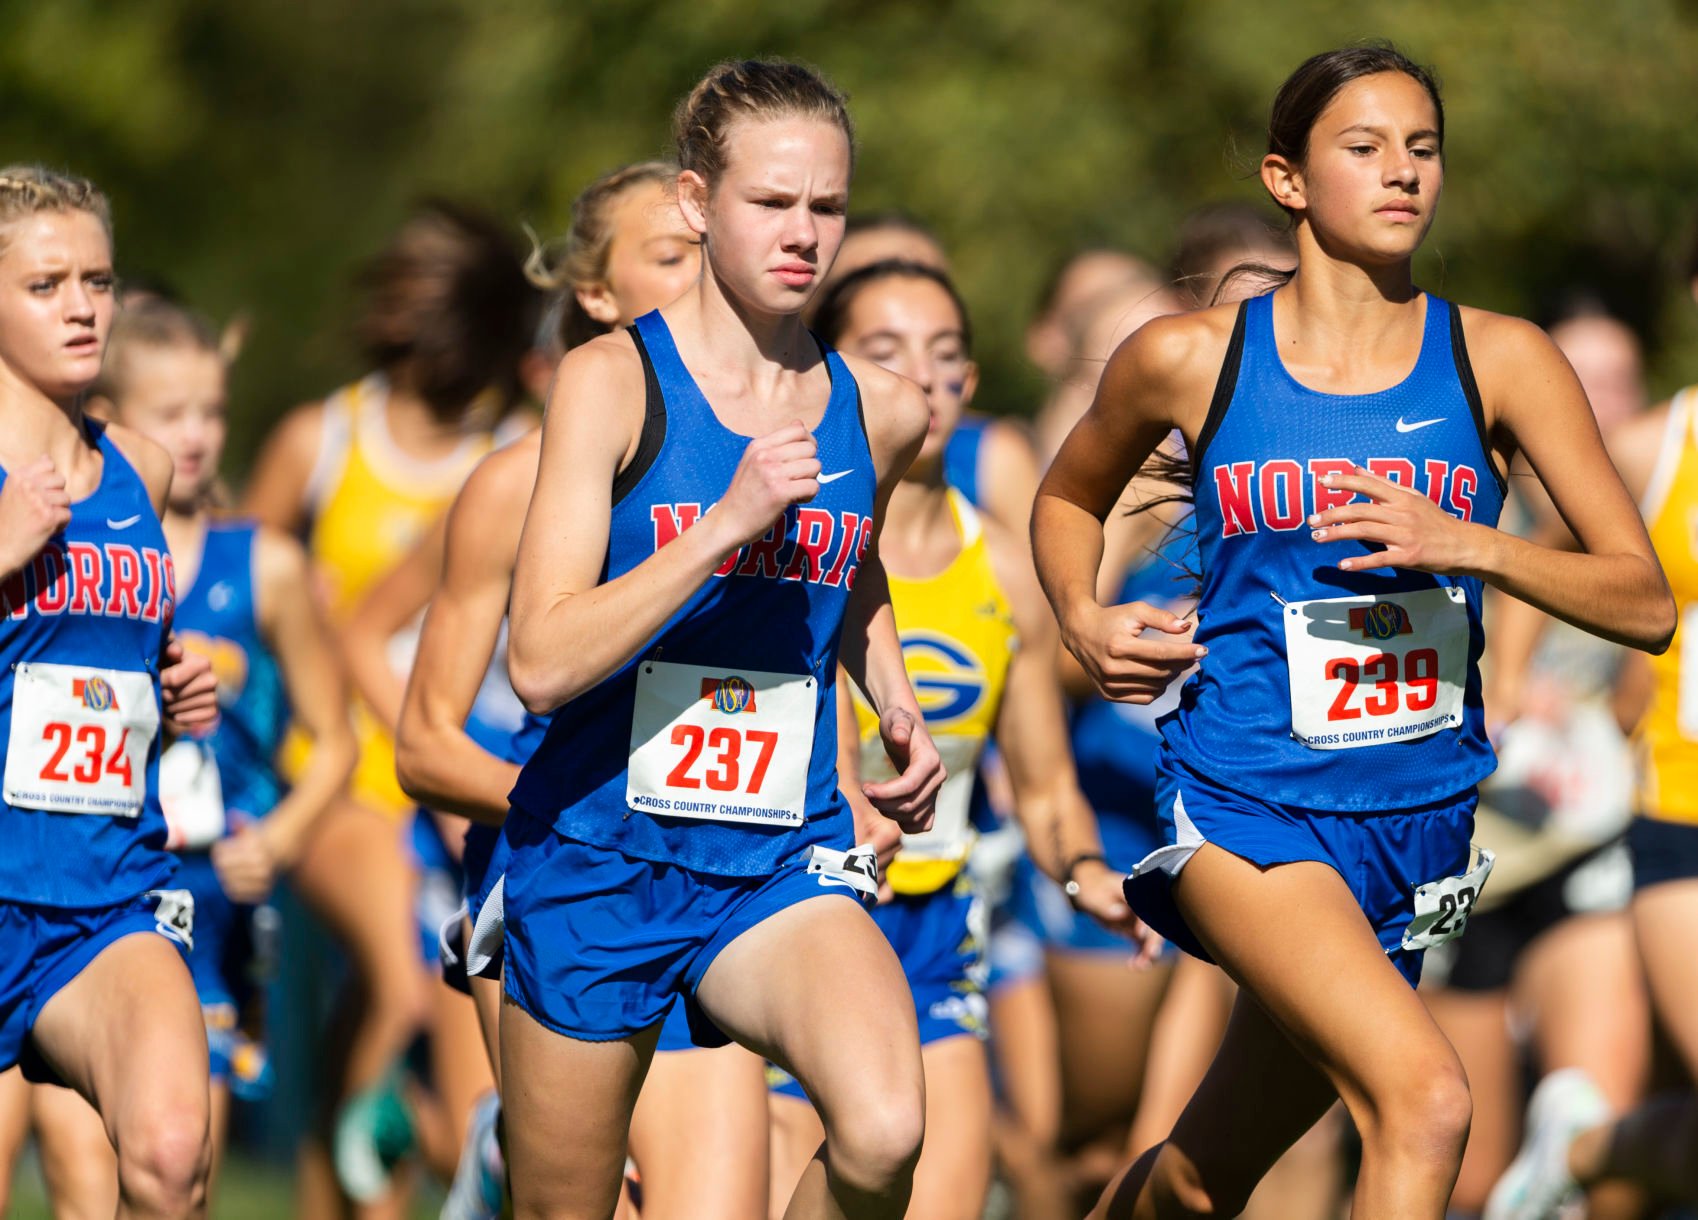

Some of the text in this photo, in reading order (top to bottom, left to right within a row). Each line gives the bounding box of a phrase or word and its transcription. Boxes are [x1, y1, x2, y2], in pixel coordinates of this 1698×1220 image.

[650, 502, 873, 592] NRRIS
[1325, 648, 1438, 721] 239
[39, 722, 132, 787] 234
[666, 724, 778, 794] 237
[1307, 714, 1449, 745] CROSS COUNTRY CHAMPIONSHIPS
[50, 792, 85, 805] COUNTRY
[639, 795, 791, 820] CROSS COUNTRY CHAMPIONSHIPS
